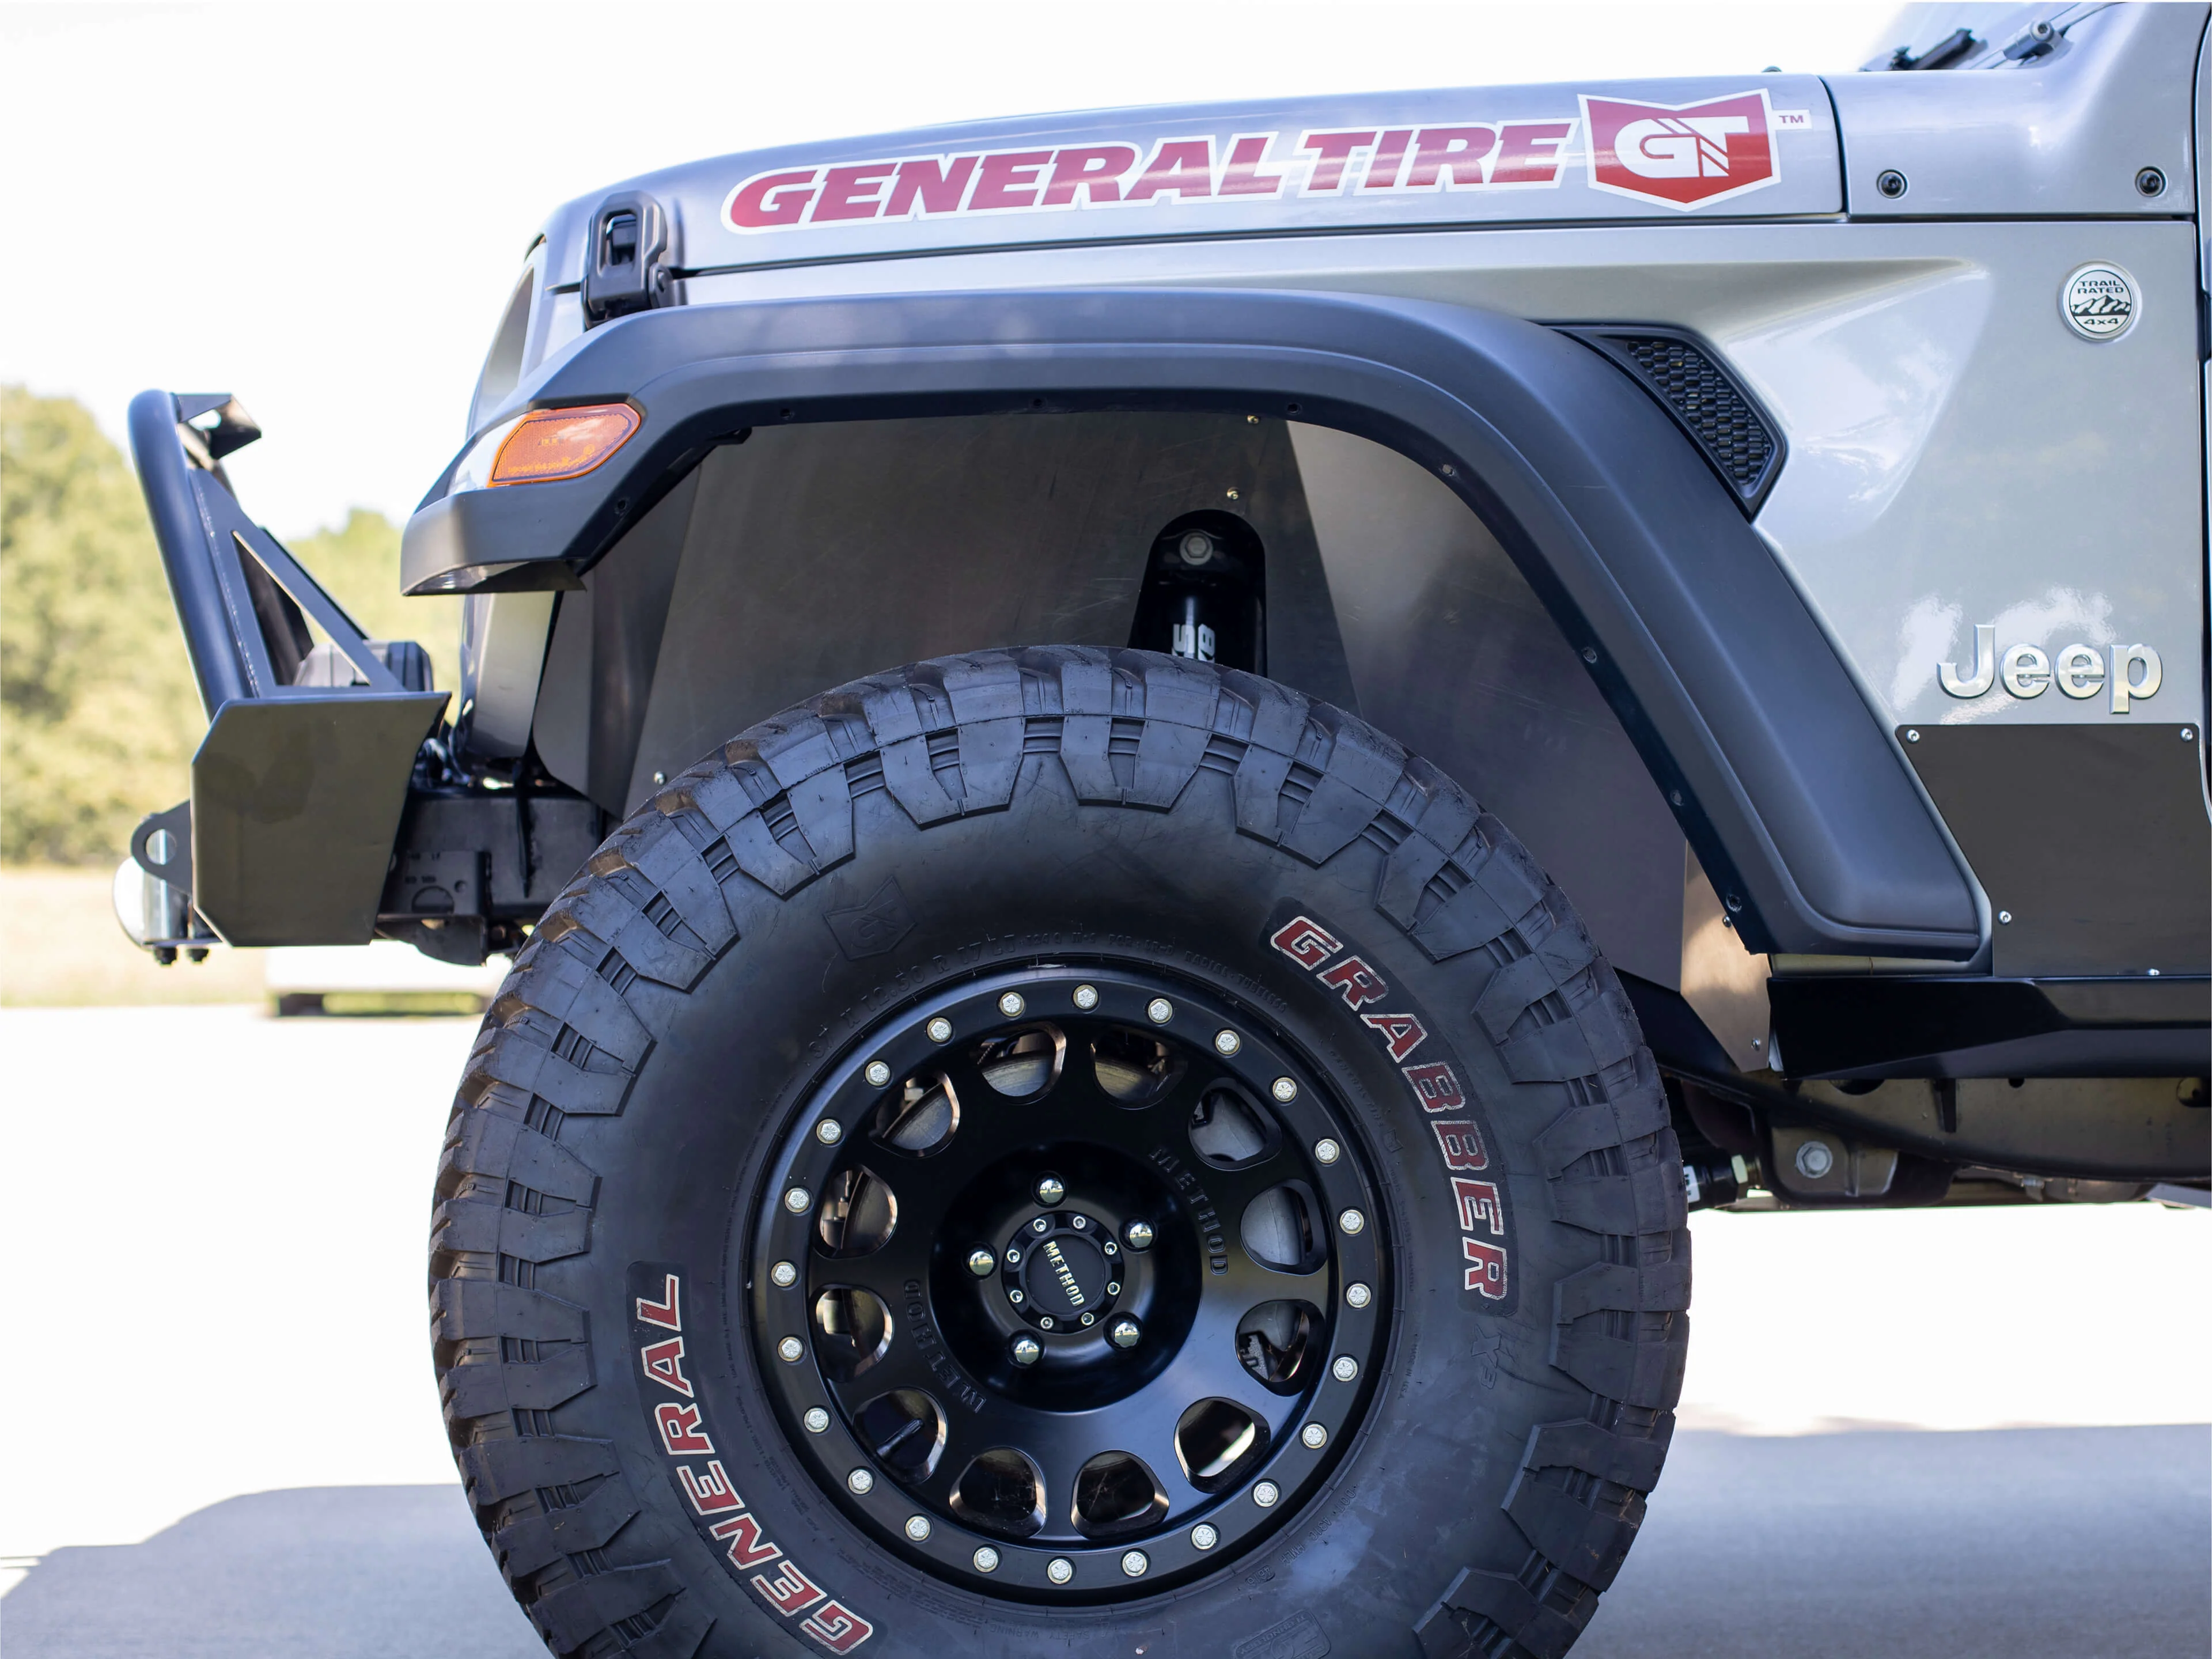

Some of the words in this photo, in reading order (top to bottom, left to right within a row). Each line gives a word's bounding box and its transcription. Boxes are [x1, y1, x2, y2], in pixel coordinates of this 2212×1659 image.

[1778, 115, 1804, 124] TM
[725, 134, 1285, 230] GENERAL
[1299, 120, 1576, 194] TIRE
[1937, 623, 2162, 714] Jeep
[1270, 916, 1508, 1301] GRABBER
[1147, 1148, 1229, 1275] METHOD
[1043, 1241, 1085, 1306] METHOD
[904, 1279, 986, 1413] METHOD
[637, 1274, 873, 1656] GENERAL
[1332, 1486, 1357, 1513] DOT
